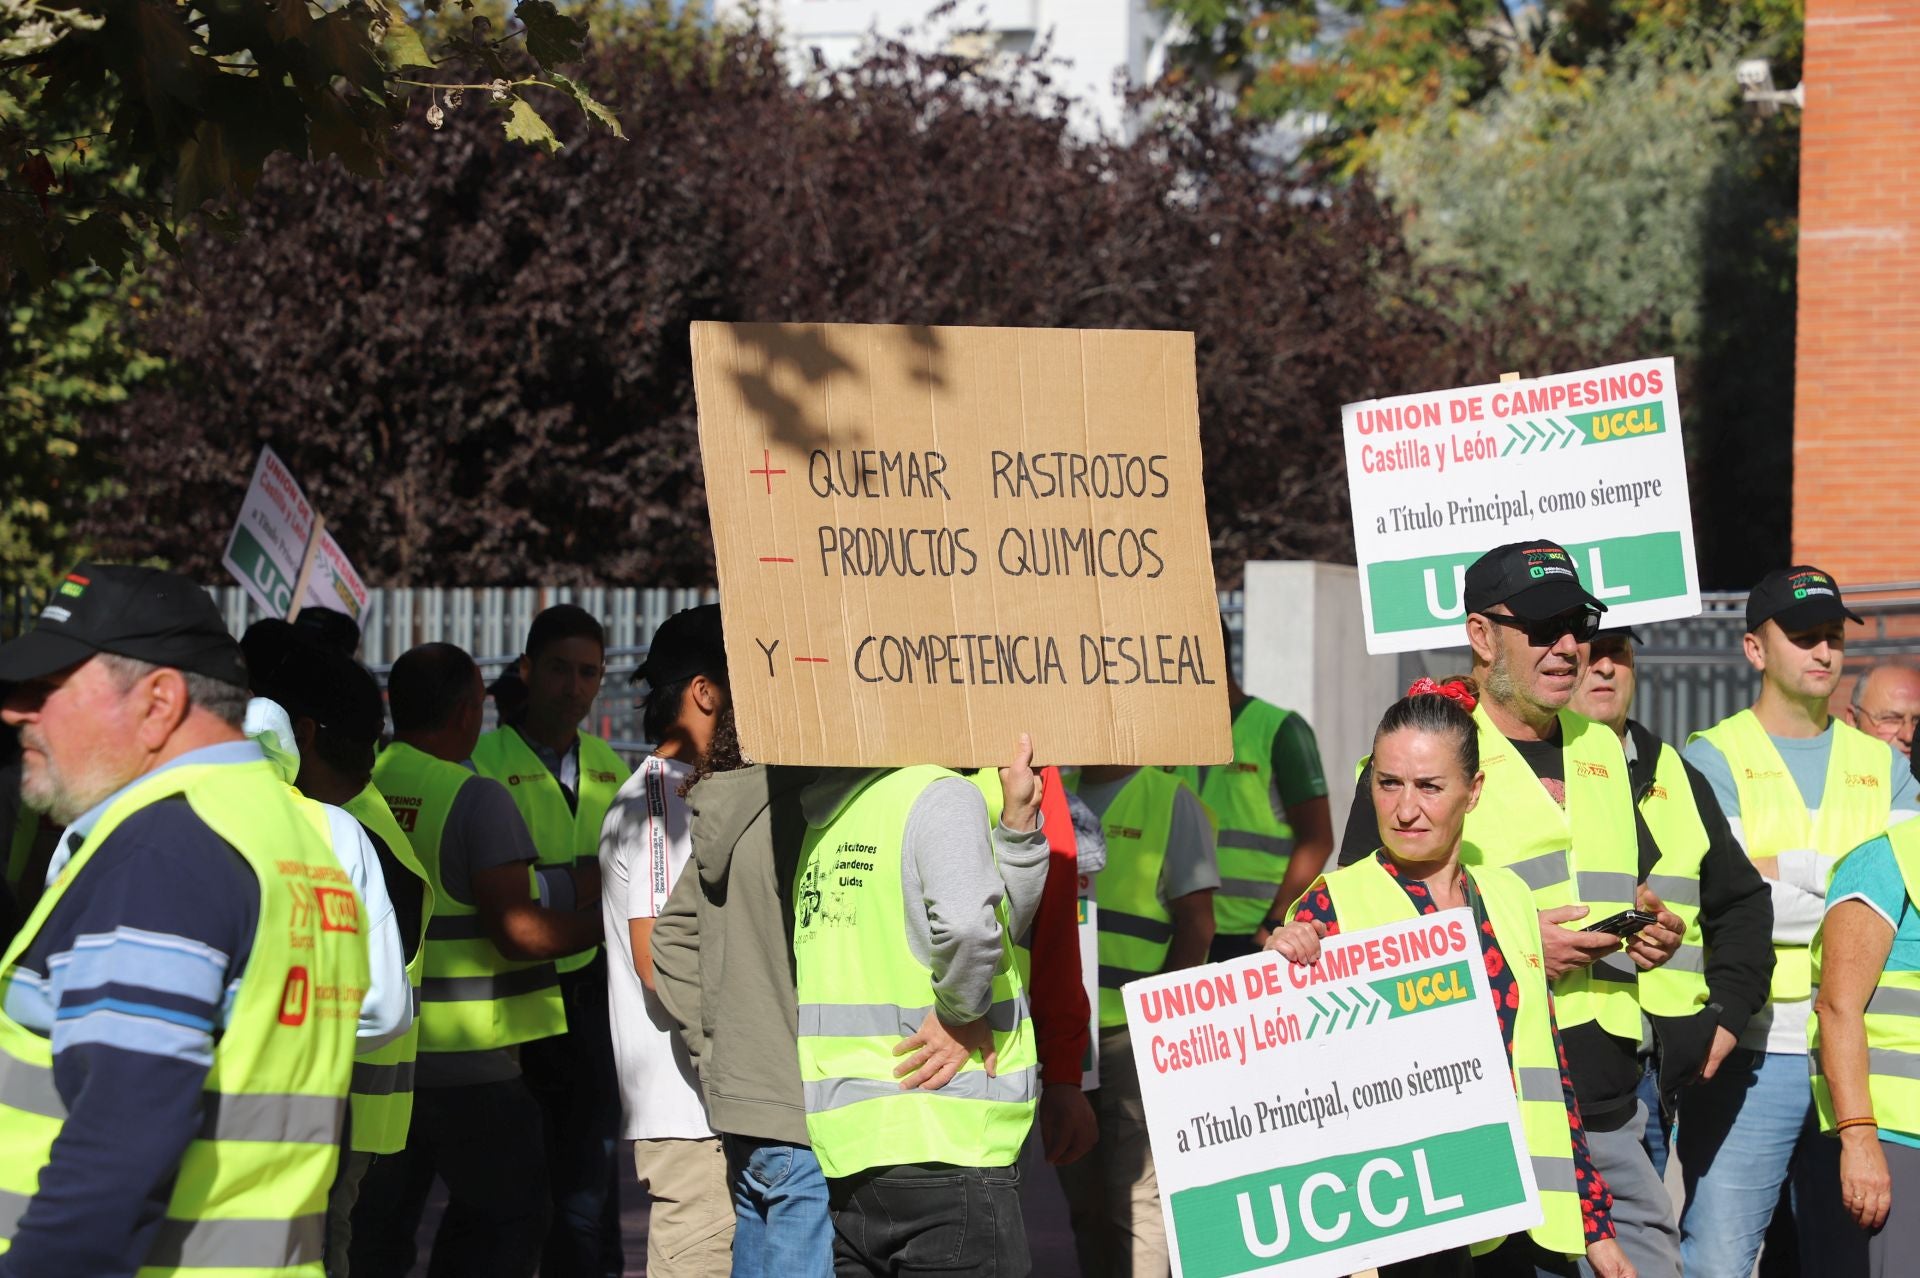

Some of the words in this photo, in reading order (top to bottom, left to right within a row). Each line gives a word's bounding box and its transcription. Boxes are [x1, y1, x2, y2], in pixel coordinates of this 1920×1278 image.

[1356, 403, 1441, 435] UNION
[1449, 397, 1484, 423] DE
[1492, 369, 1664, 418] CAMPESINOS
[1362, 439, 1431, 474] Castilla
[1435, 443, 1446, 473] y
[1452, 430, 1497, 462] León
[1592, 407, 1658, 441] UCCL
[265, 454, 298, 499] UNION
[809, 449, 951, 500] QUEMAR
[991, 450, 1169, 499] RASTROJOS
[1376, 514, 1387, 534] a
[1390, 501, 1443, 532] Título
[1448, 490, 1534, 525] Principal,
[1538, 489, 1586, 514] como
[1591, 478, 1662, 509] siempre
[818, 525, 977, 577] PRODUCTOS
[998, 527, 1164, 578] QUIMICOS
[755, 637, 780, 677] Y
[854, 634, 1067, 685] COMPETENCIA
[1080, 634, 1215, 685] DESLEAL
[1140, 973, 1237, 1024] UNION
[1243, 963, 1282, 1000] DE
[1288, 921, 1467, 990] CAMPESINOS
[1152, 1023, 1231, 1074] Castilla
[1233, 1026, 1246, 1066] y
[1249, 1007, 1302, 1051] León
[1397, 970, 1468, 1012] UCCL
[1176, 1129, 1191, 1153] a
[1191, 1106, 1253, 1150] Título
[1254, 1081, 1349, 1134] Principal,
[1352, 1077, 1403, 1110] como
[1407, 1057, 1484, 1097] siempre
[1236, 1148, 1464, 1259] UCCL
